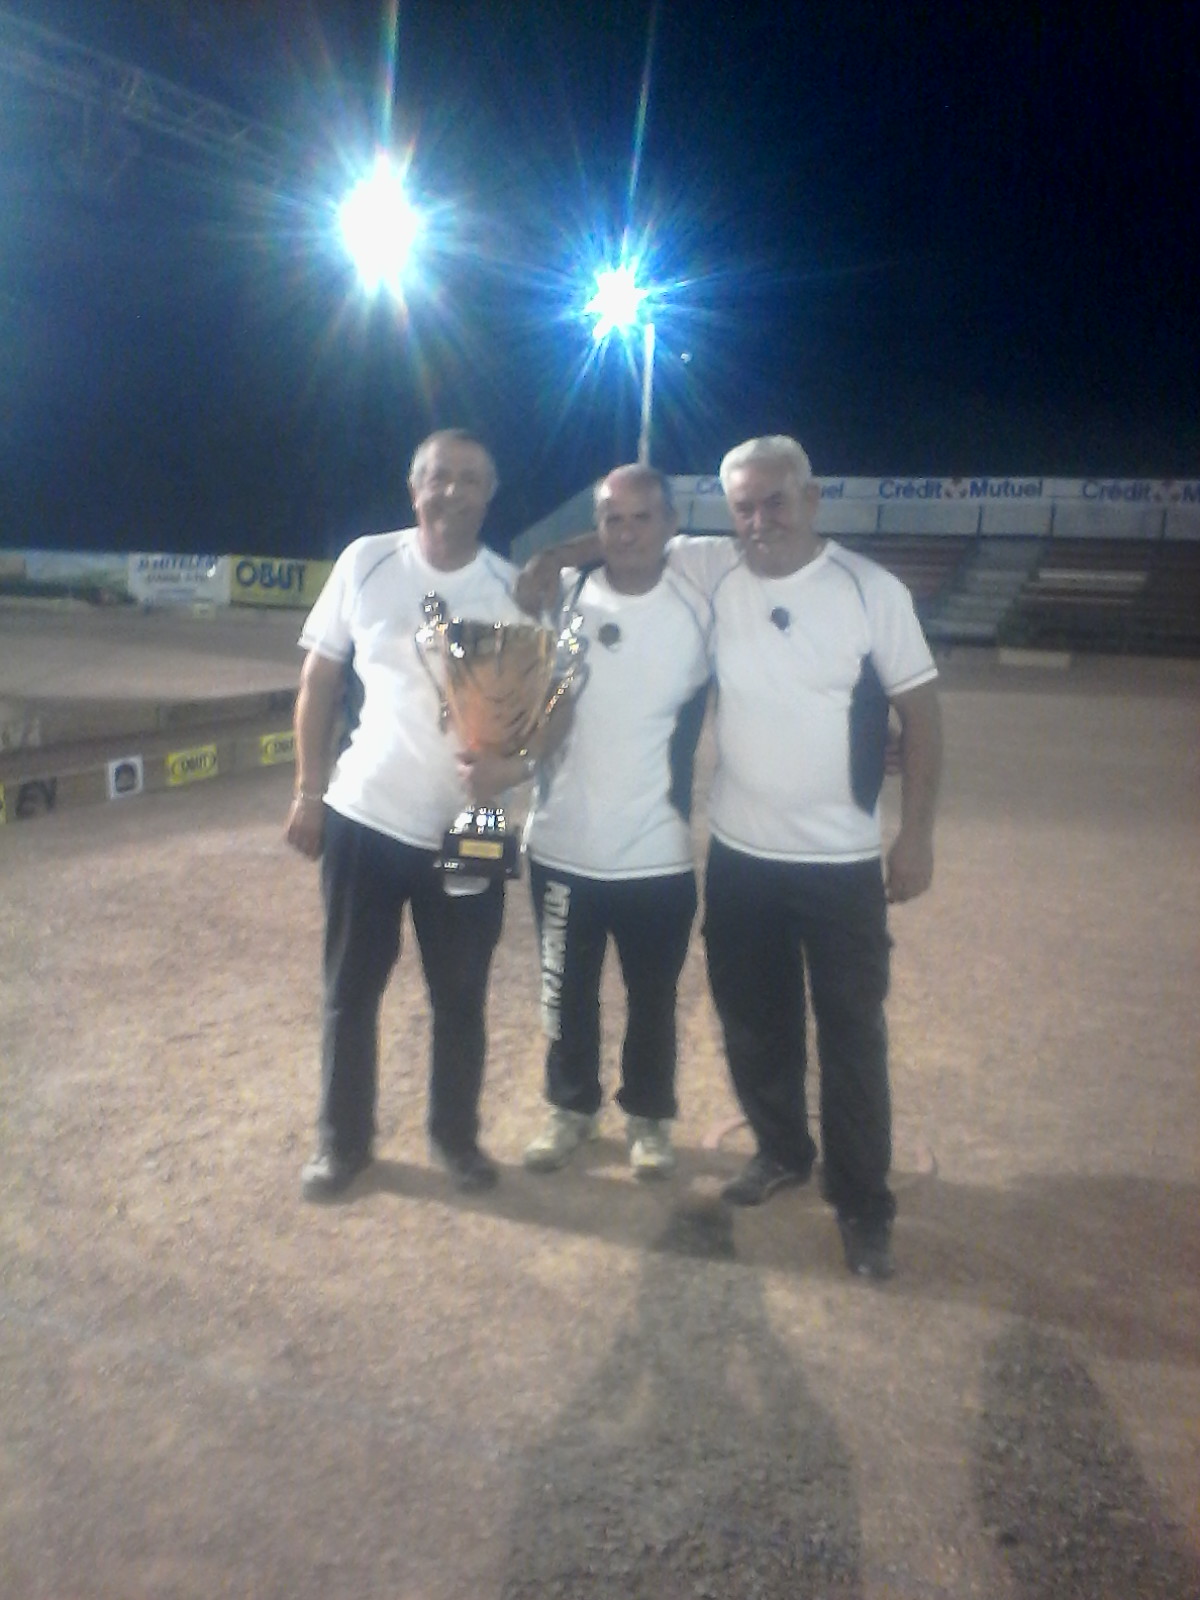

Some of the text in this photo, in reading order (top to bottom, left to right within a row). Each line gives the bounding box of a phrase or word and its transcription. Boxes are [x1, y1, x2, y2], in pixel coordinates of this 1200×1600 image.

[879, 477, 1042, 499] Crédit Mutuel
[1082, 479, 1151, 502] Crédit
[236, 559, 306, 592] OBUT
